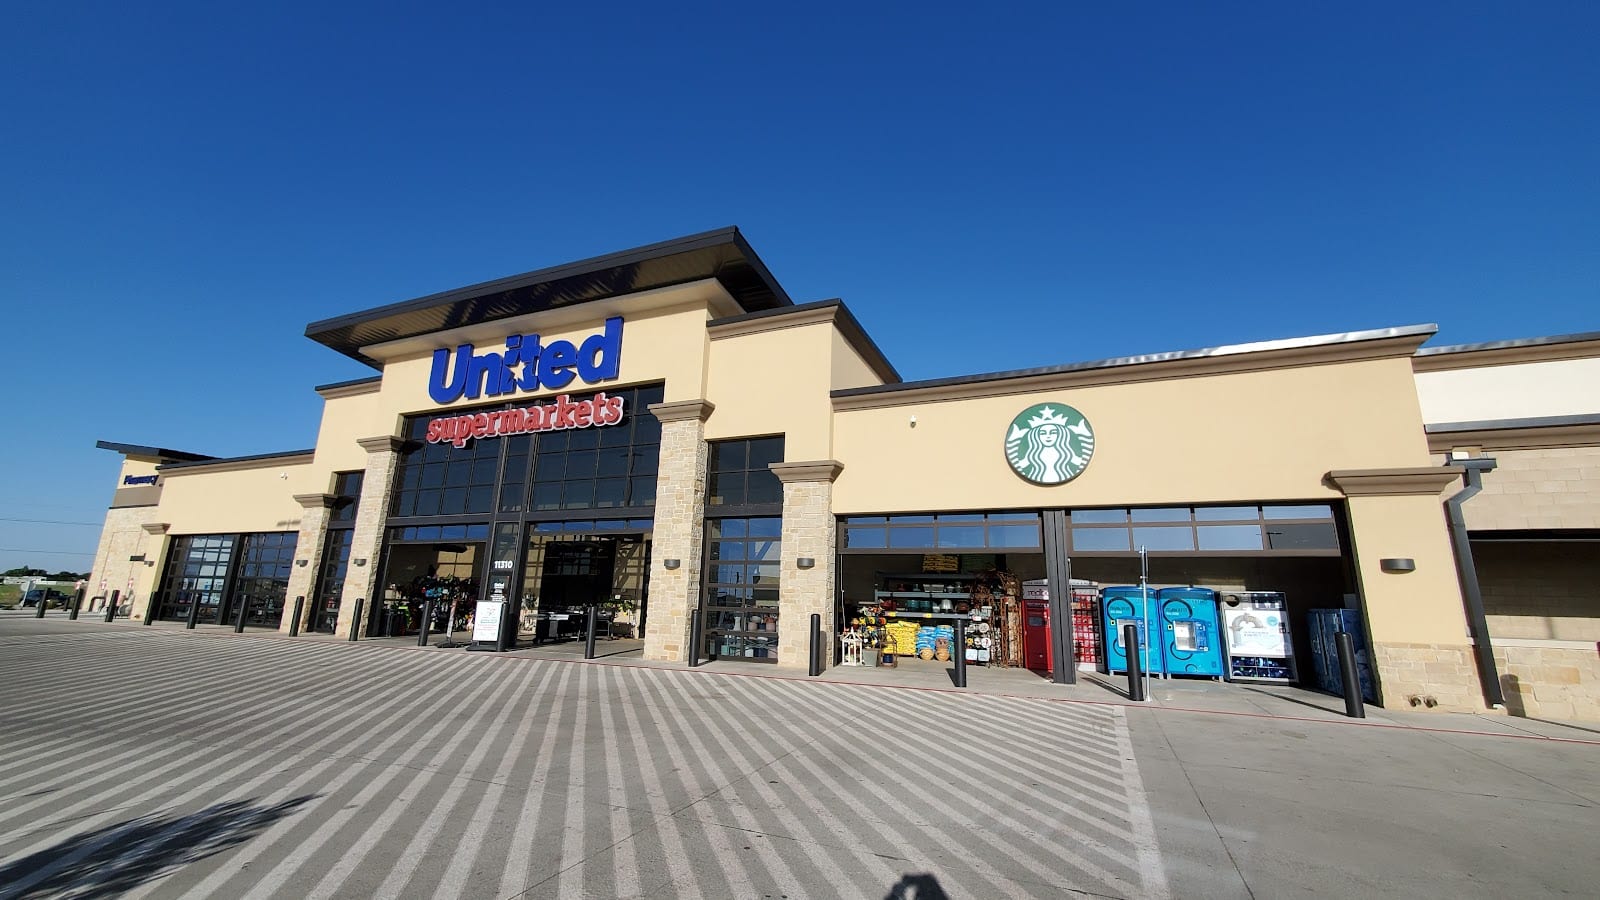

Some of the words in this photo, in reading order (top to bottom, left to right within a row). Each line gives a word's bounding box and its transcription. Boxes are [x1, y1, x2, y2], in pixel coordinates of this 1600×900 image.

[428, 316, 624, 405] United
[426, 392, 624, 449] supermarkets
[494, 560, 513, 569] 11310
